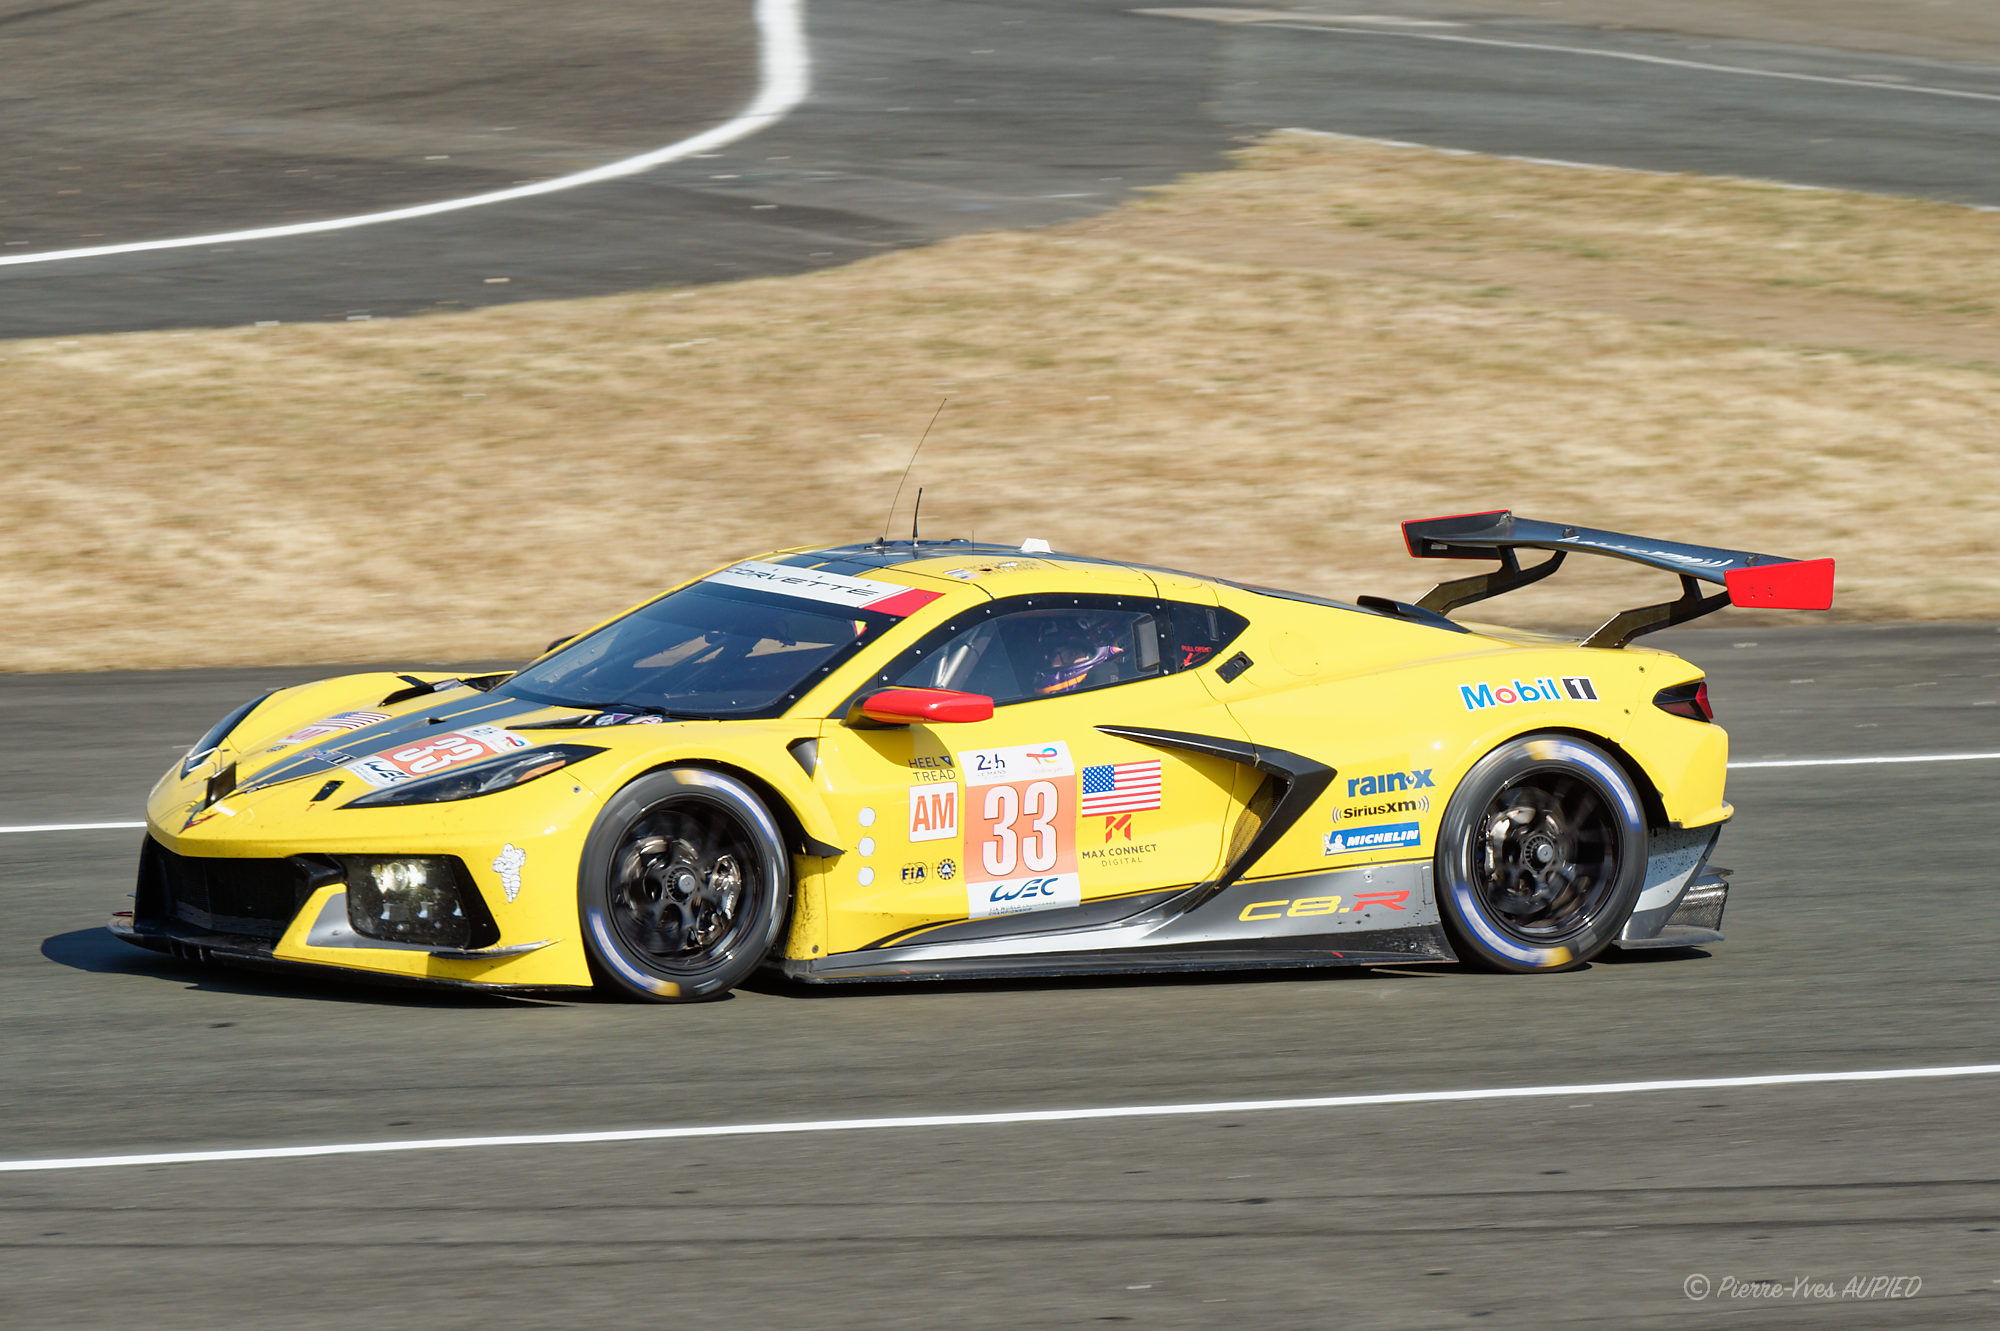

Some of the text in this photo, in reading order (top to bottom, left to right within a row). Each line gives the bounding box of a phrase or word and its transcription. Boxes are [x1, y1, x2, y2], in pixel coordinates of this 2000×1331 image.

[724, 567, 879, 597] CORVETTE
[1461, 678, 1593, 710] Mobil 1
[392, 737, 484, 774] 33
[908, 756, 941, 768] HEEL
[913, 769, 956, 781] TREAD
[912, 792, 955, 833] AM
[982, 781, 1059, 876] 33
[1346, 829, 1420, 847] MICHELIN
[1082, 843, 1157, 859] MAX CONNECT
[1101, 857, 1143, 867] DIGITAL
[990, 877, 1059, 902] WEC
[1238, 890, 1411, 922] C8.R
